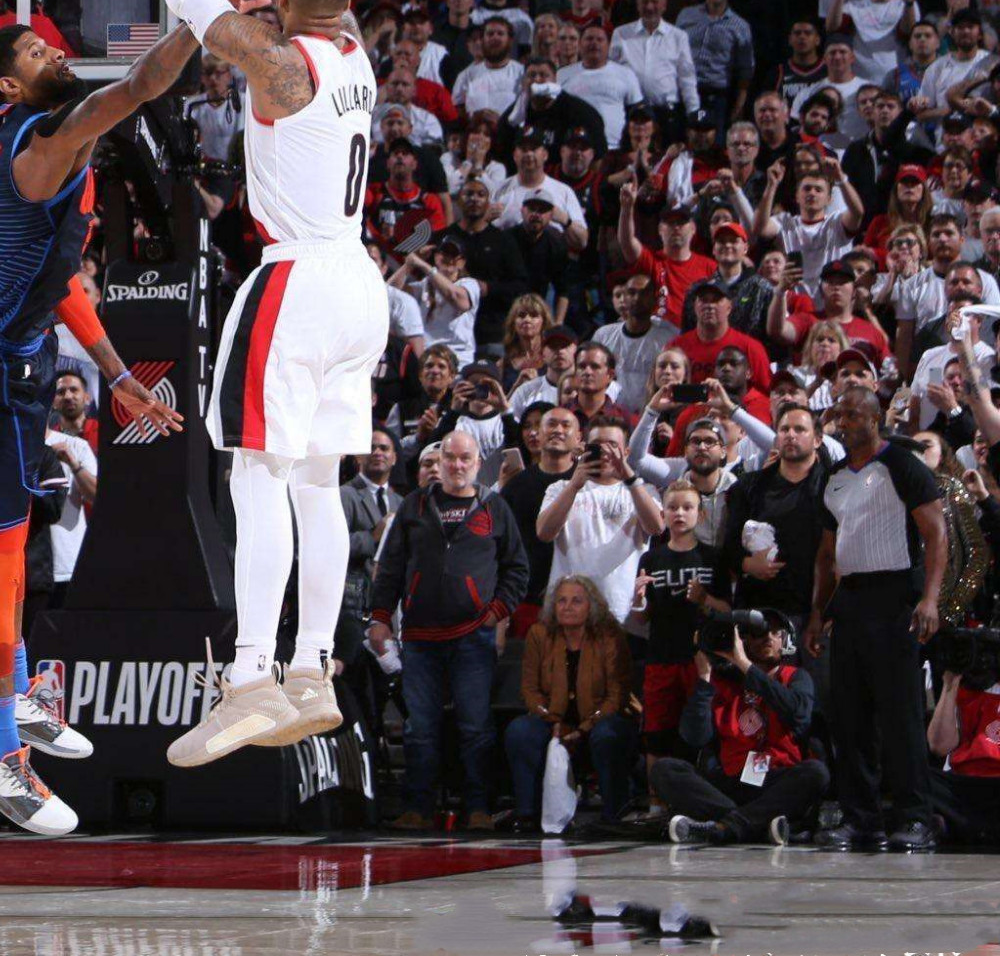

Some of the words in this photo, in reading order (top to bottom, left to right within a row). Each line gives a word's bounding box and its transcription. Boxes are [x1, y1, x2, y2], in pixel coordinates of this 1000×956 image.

[344, 133, 367, 217] 0
[106, 282, 188, 303] SPALDING
[650, 566, 714, 588] ELITE
[69, 660, 234, 726] PLAYOFF
